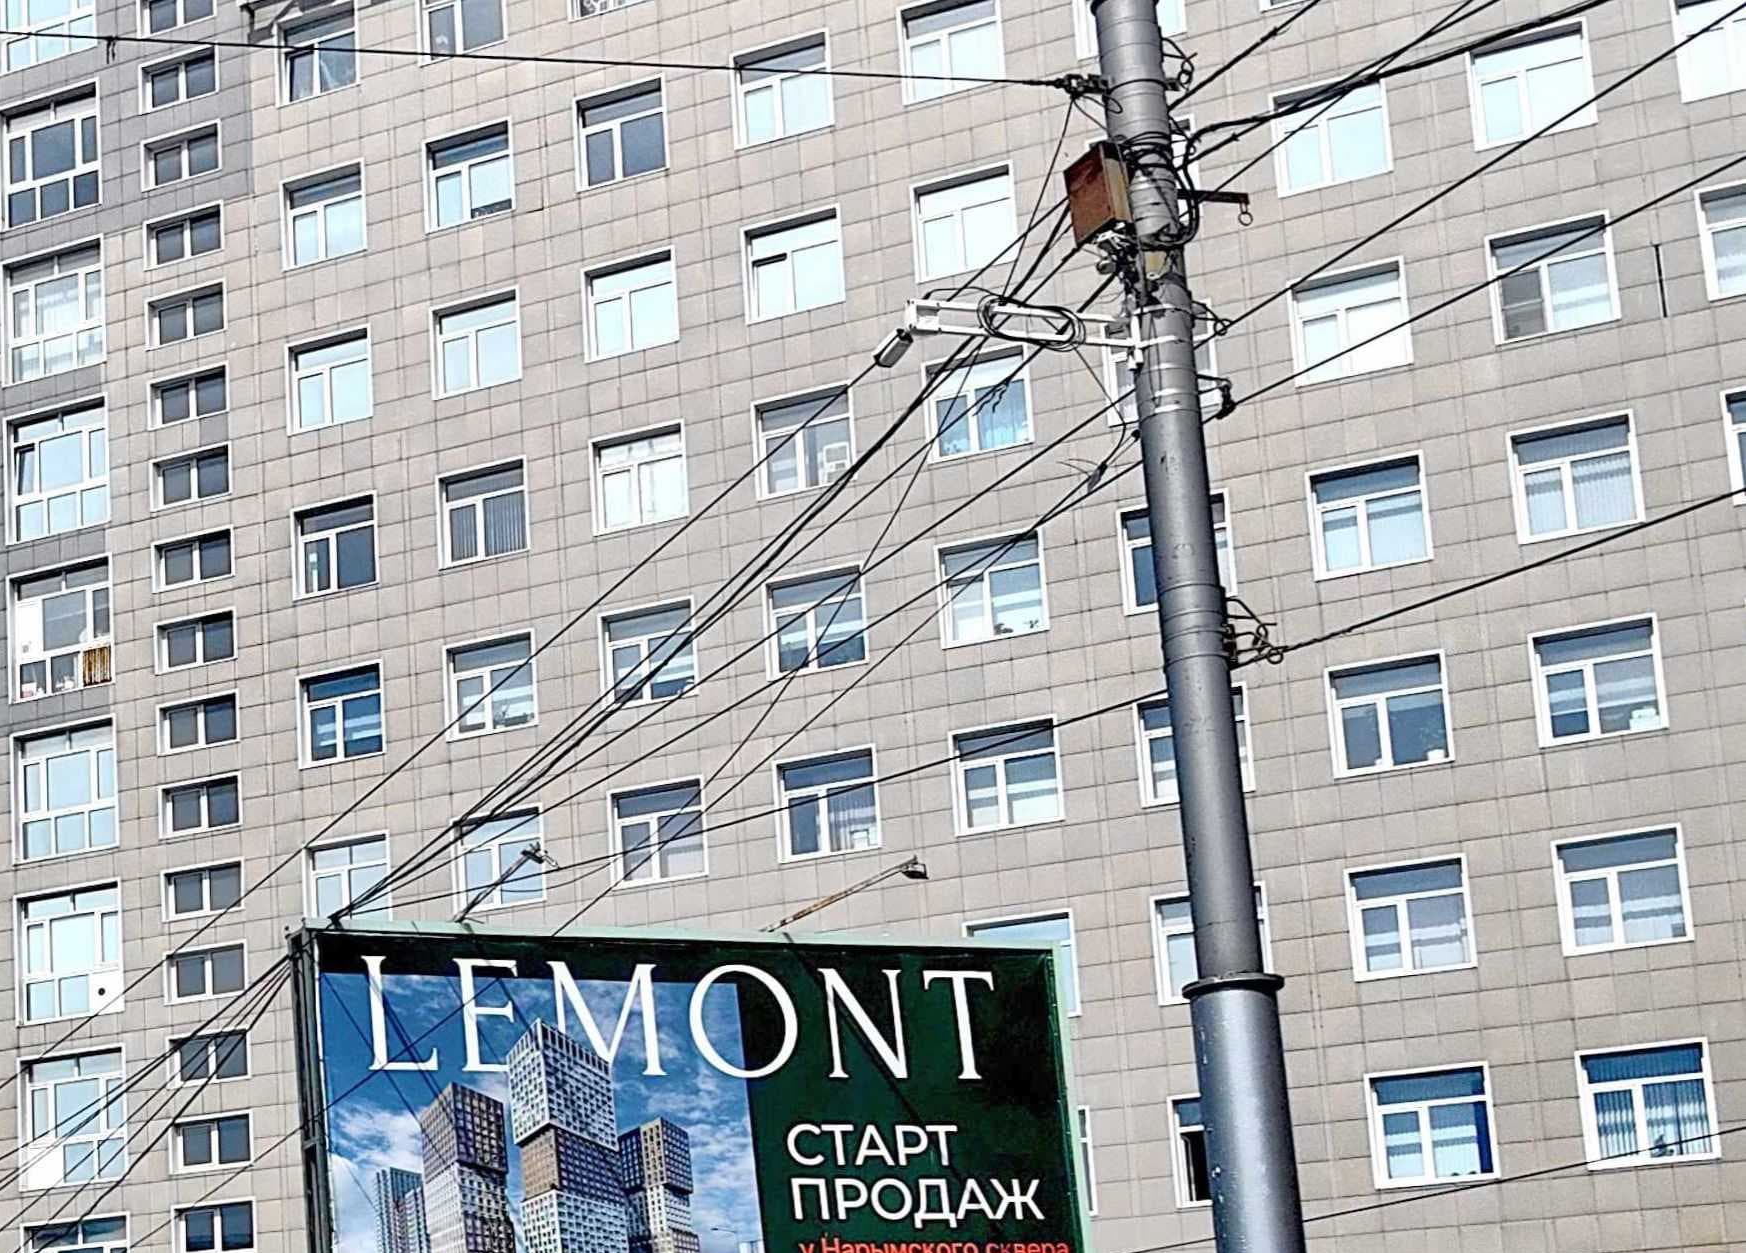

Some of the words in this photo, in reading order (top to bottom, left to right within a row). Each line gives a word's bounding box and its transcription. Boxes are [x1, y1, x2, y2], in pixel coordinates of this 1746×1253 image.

[362, 955, 994, 1080] LEMONT
[787, 1123, 957, 1167] СТАРТ
[792, 1177, 1044, 1228] ПРОДАЖ
